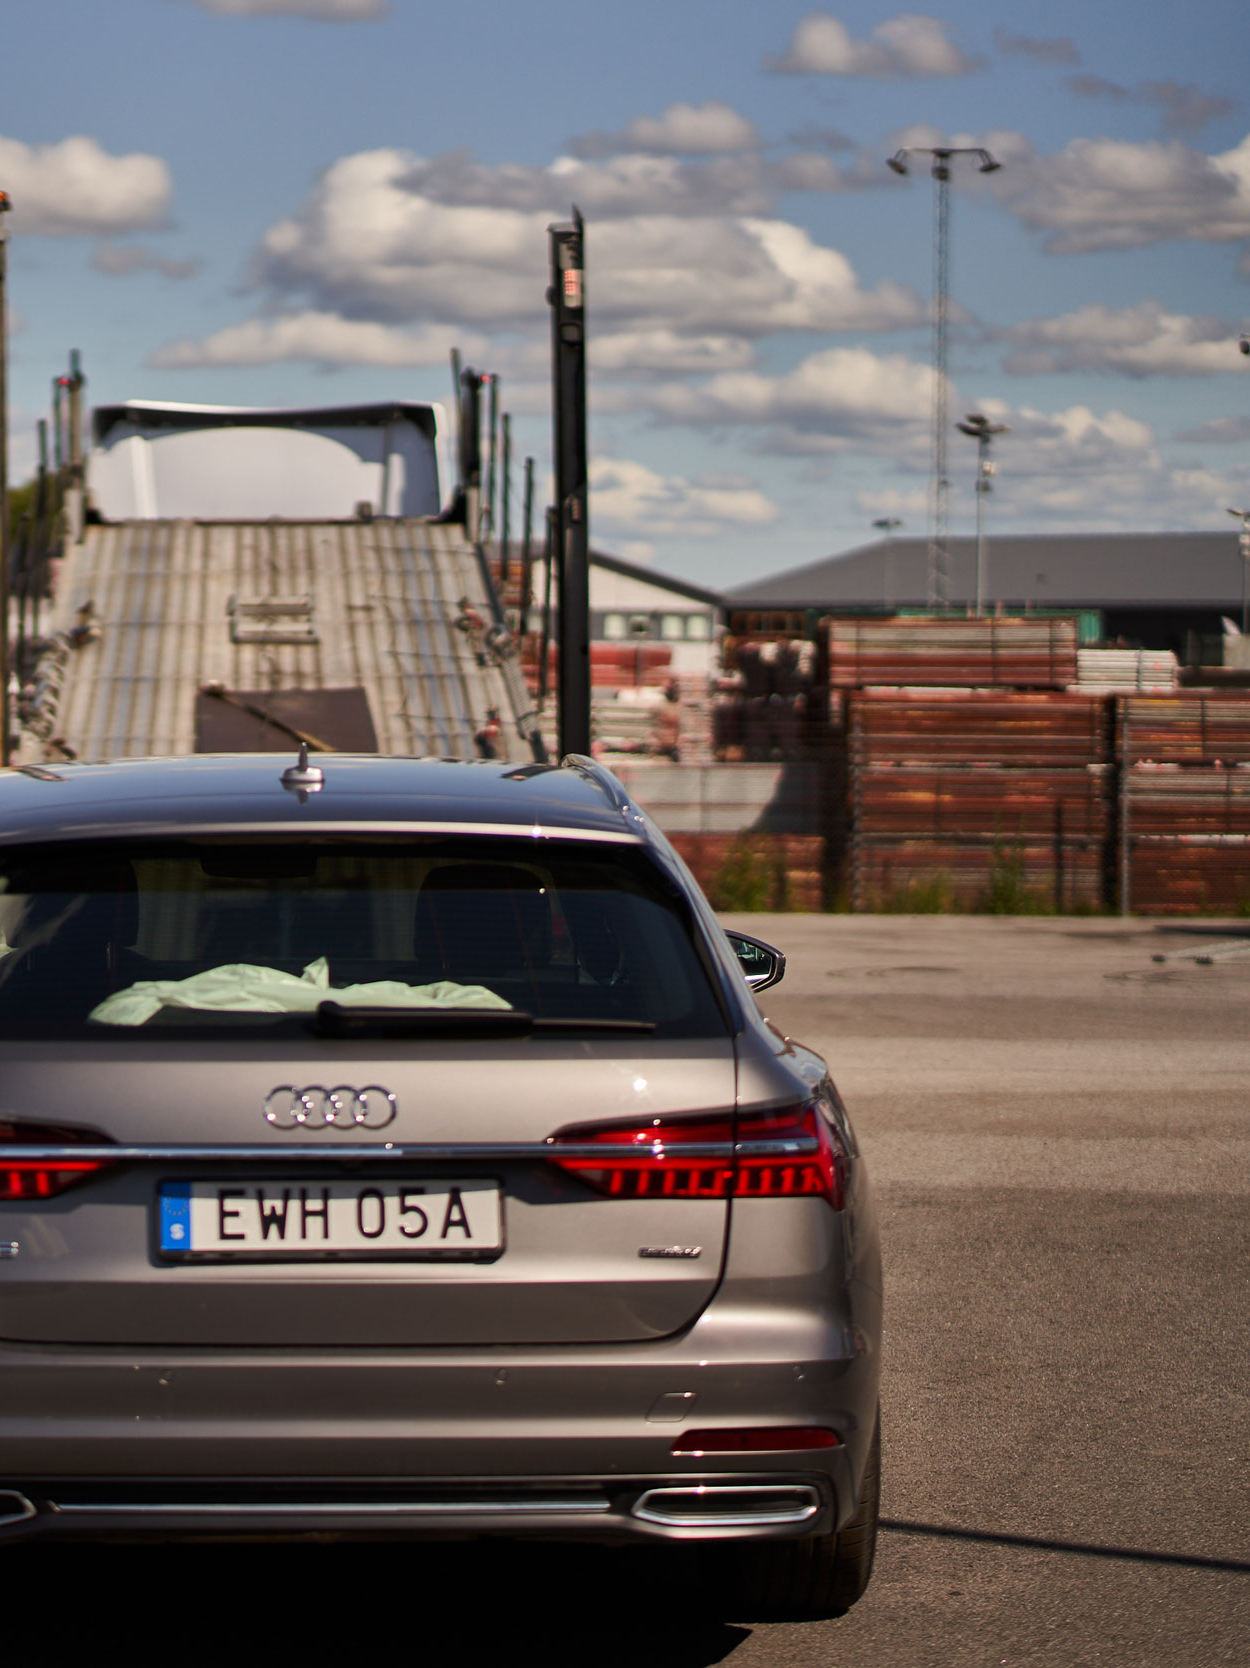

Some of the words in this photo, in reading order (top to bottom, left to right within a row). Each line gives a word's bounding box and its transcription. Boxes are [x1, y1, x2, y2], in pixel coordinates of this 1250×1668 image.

[217, 1188, 330, 1240] EWH
[356, 1187, 472, 1239] 05A
[170, 1223, 185, 1240] S
